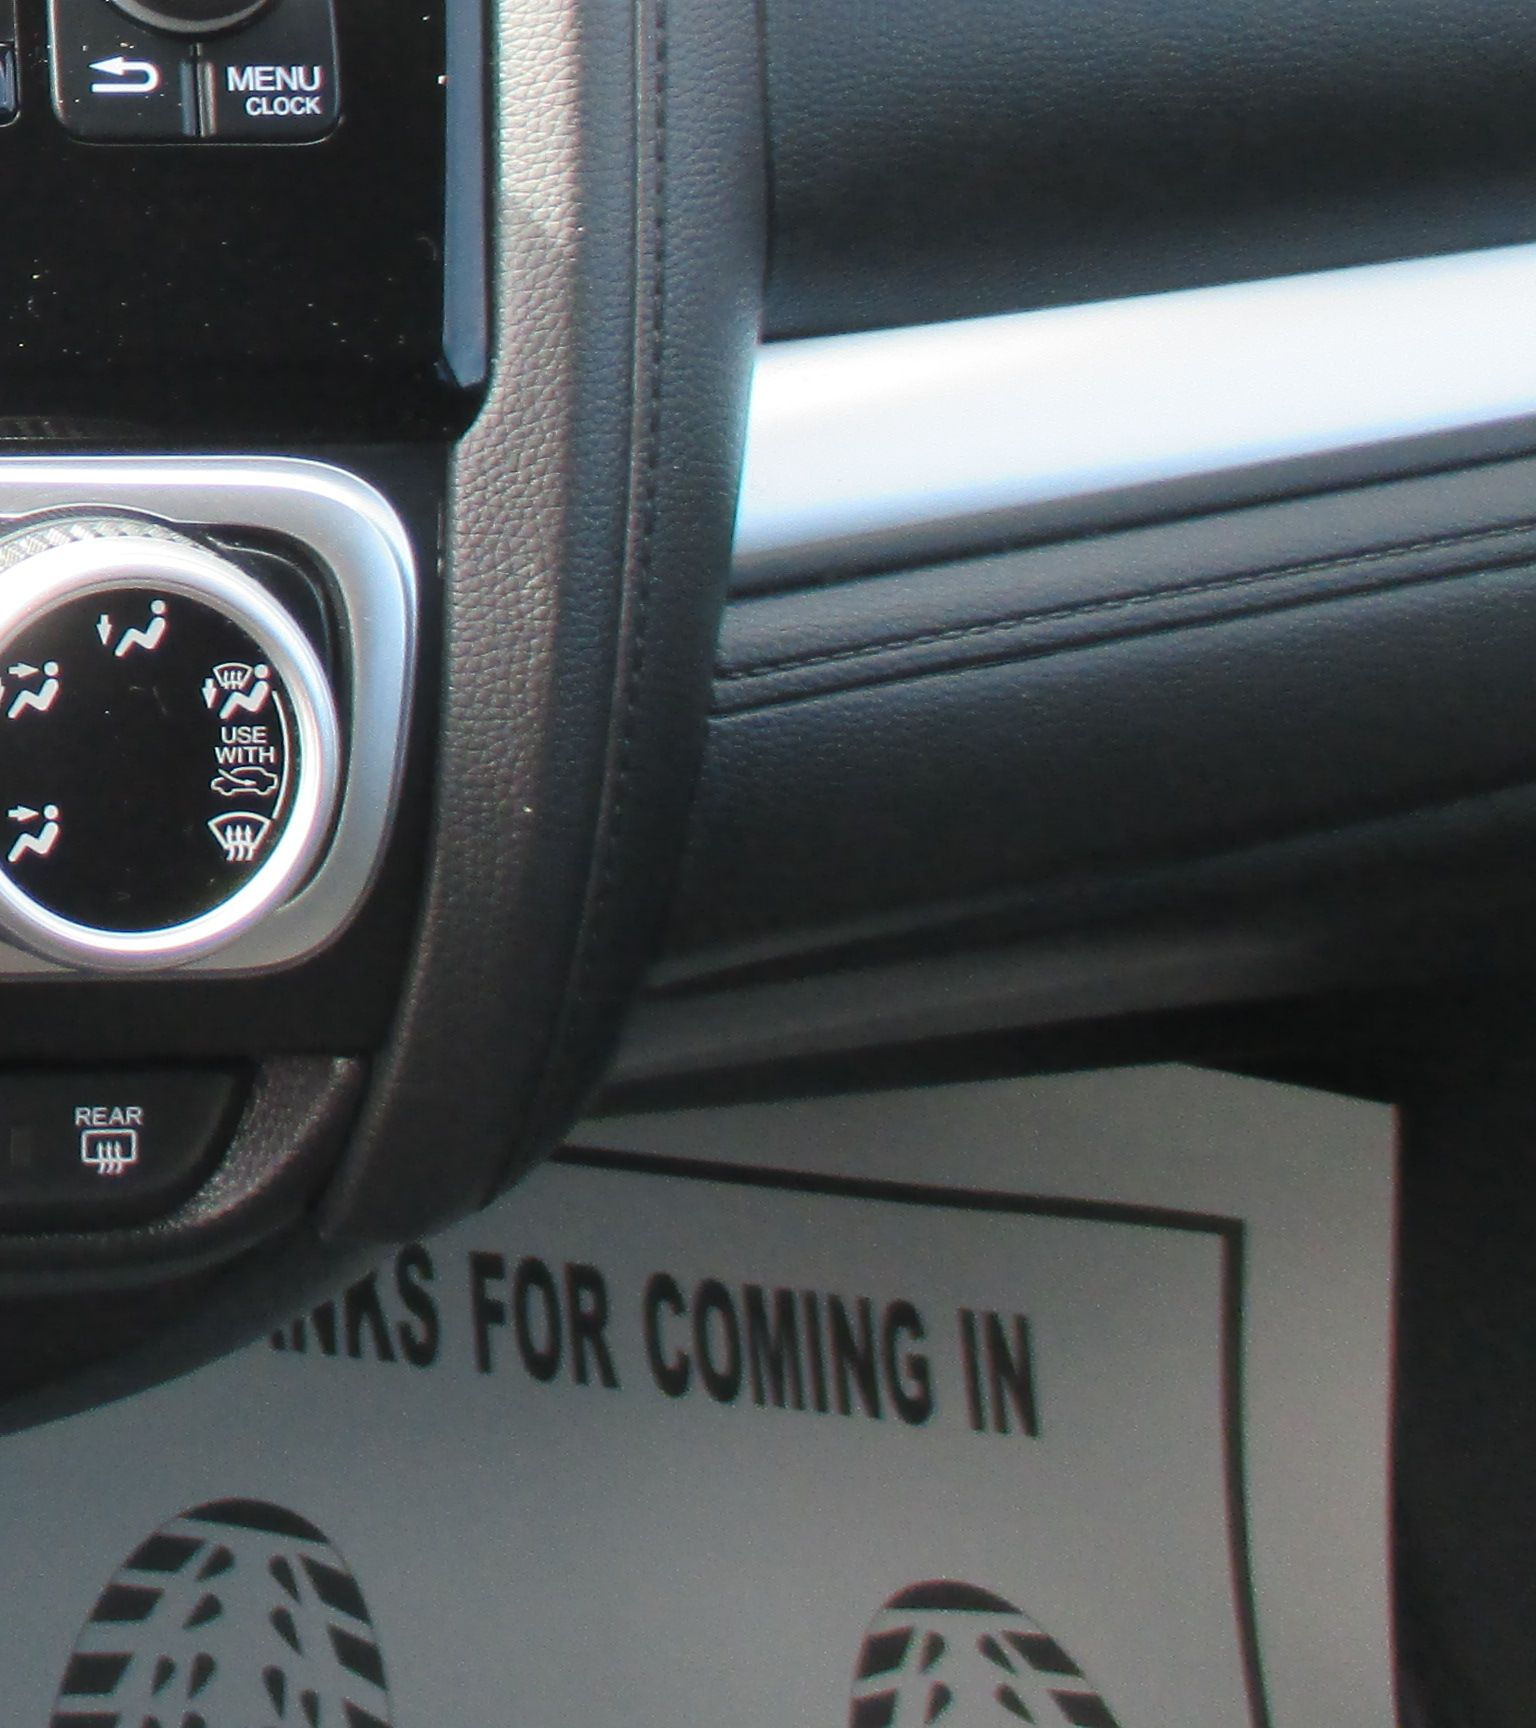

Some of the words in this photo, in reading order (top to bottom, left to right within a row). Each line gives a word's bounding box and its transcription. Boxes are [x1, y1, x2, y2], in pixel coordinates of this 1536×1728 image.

[227, 65, 322, 92] MENU
[245, 96, 321, 116] CLOCK
[221, 726, 267, 745] USE
[214, 746, 276, 765] WITH
[75, 1106, 143, 1127] REAR
[467, 1250, 622, 1390] FOR
[642, 1273, 931, 1426] COMING
[956, 1308, 1040, 1438] IN
